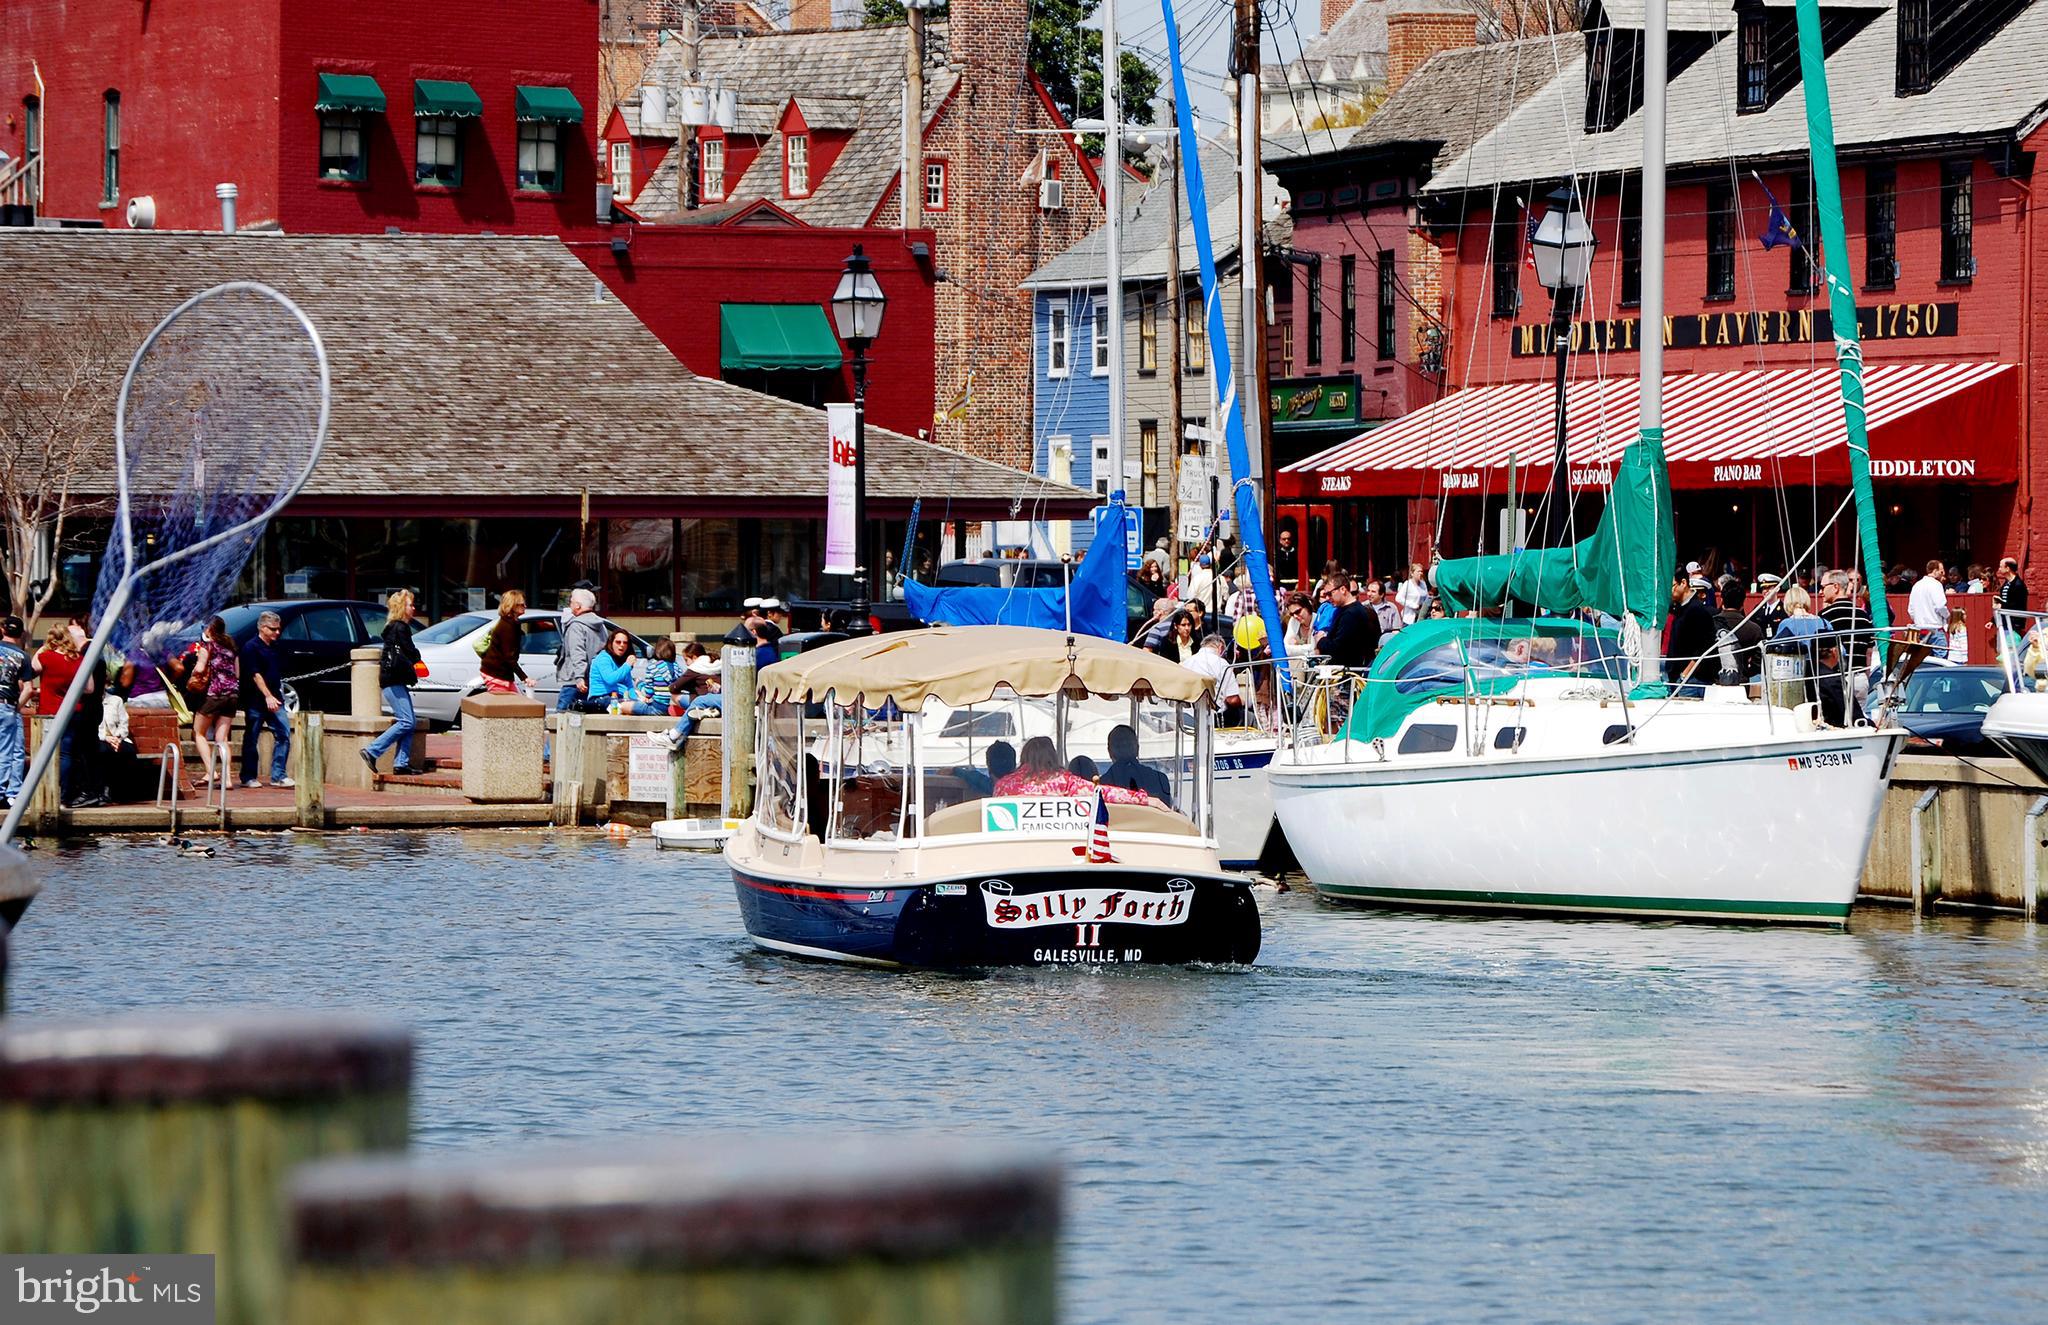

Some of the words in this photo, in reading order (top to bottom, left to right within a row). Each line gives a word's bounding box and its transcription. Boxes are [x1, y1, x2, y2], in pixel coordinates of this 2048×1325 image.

[1520, 315, 1674, 355] MIDLETN
[1698, 309, 1812, 345] TAVERN
[1875, 302, 1940, 338] 1750
[1713, 464, 1742, 482] PIANO
[1742, 464, 1762, 481] BAR
[1869, 459, 1976, 477] IDDLETON
[1321, 475, 1352, 491] STEAKS
[1442, 473, 1461, 489] RAW
[1461, 472, 1479, 488] BAR
[1571, 468, 1612, 486] SEAFOOD
[1180, 484, 1193, 499] 3/4
[1184, 524, 1200, 538] 15
[1797, 756, 1812, 769] MD
[1814, 753, 1840, 769] 5238
[1841, 752, 1853, 765] AV
[1022, 800, 1092, 818] ZERO
[993, 893, 1087, 924] Sally
[1093, 891, 1185, 921] Forth
[1033, 948, 1119, 964] GALESVILLE,
[1124, 948, 1143, 962] MD
